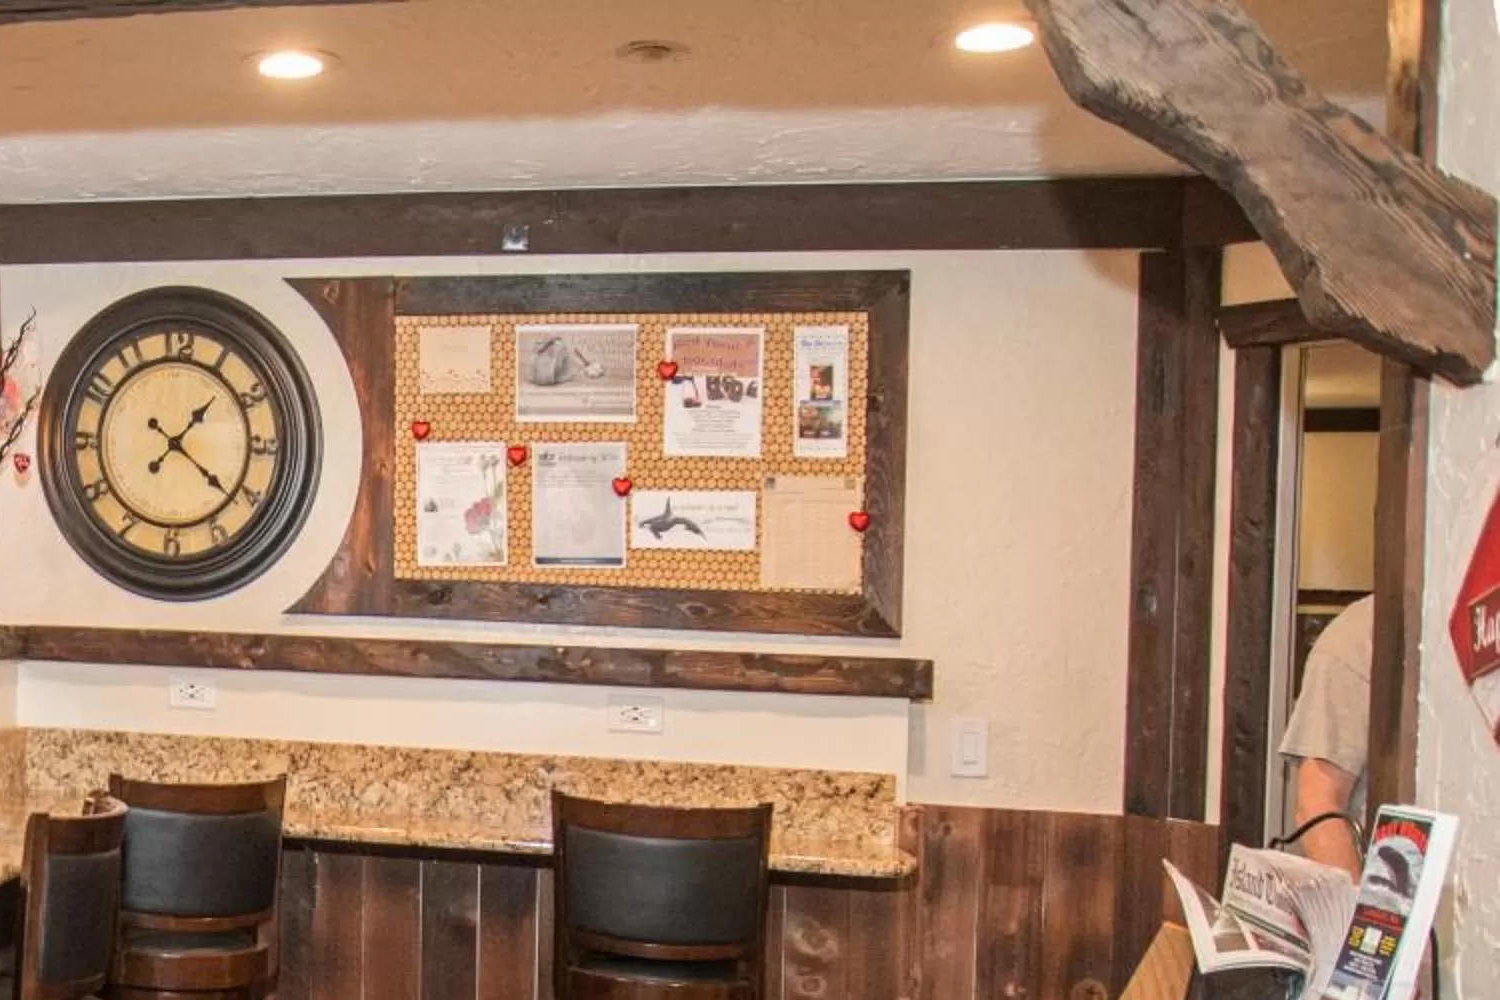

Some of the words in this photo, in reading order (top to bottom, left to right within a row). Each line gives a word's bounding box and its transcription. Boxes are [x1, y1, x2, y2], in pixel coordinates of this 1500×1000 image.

[117, 341, 143, 369] 11
[164, 333, 195, 361] 12
[214, 349, 232, 370] 1
[87, 372, 114, 402] 10
[240, 382, 267, 411] 2
[74, 430, 99, 451] 9
[250, 434, 278, 455] 3
[83, 479, 109, 500] 8
[233, 484, 263, 508] 4
[118, 510, 140, 538] 7
[209, 515, 229, 543] 5
[162, 528, 181, 557] 6
